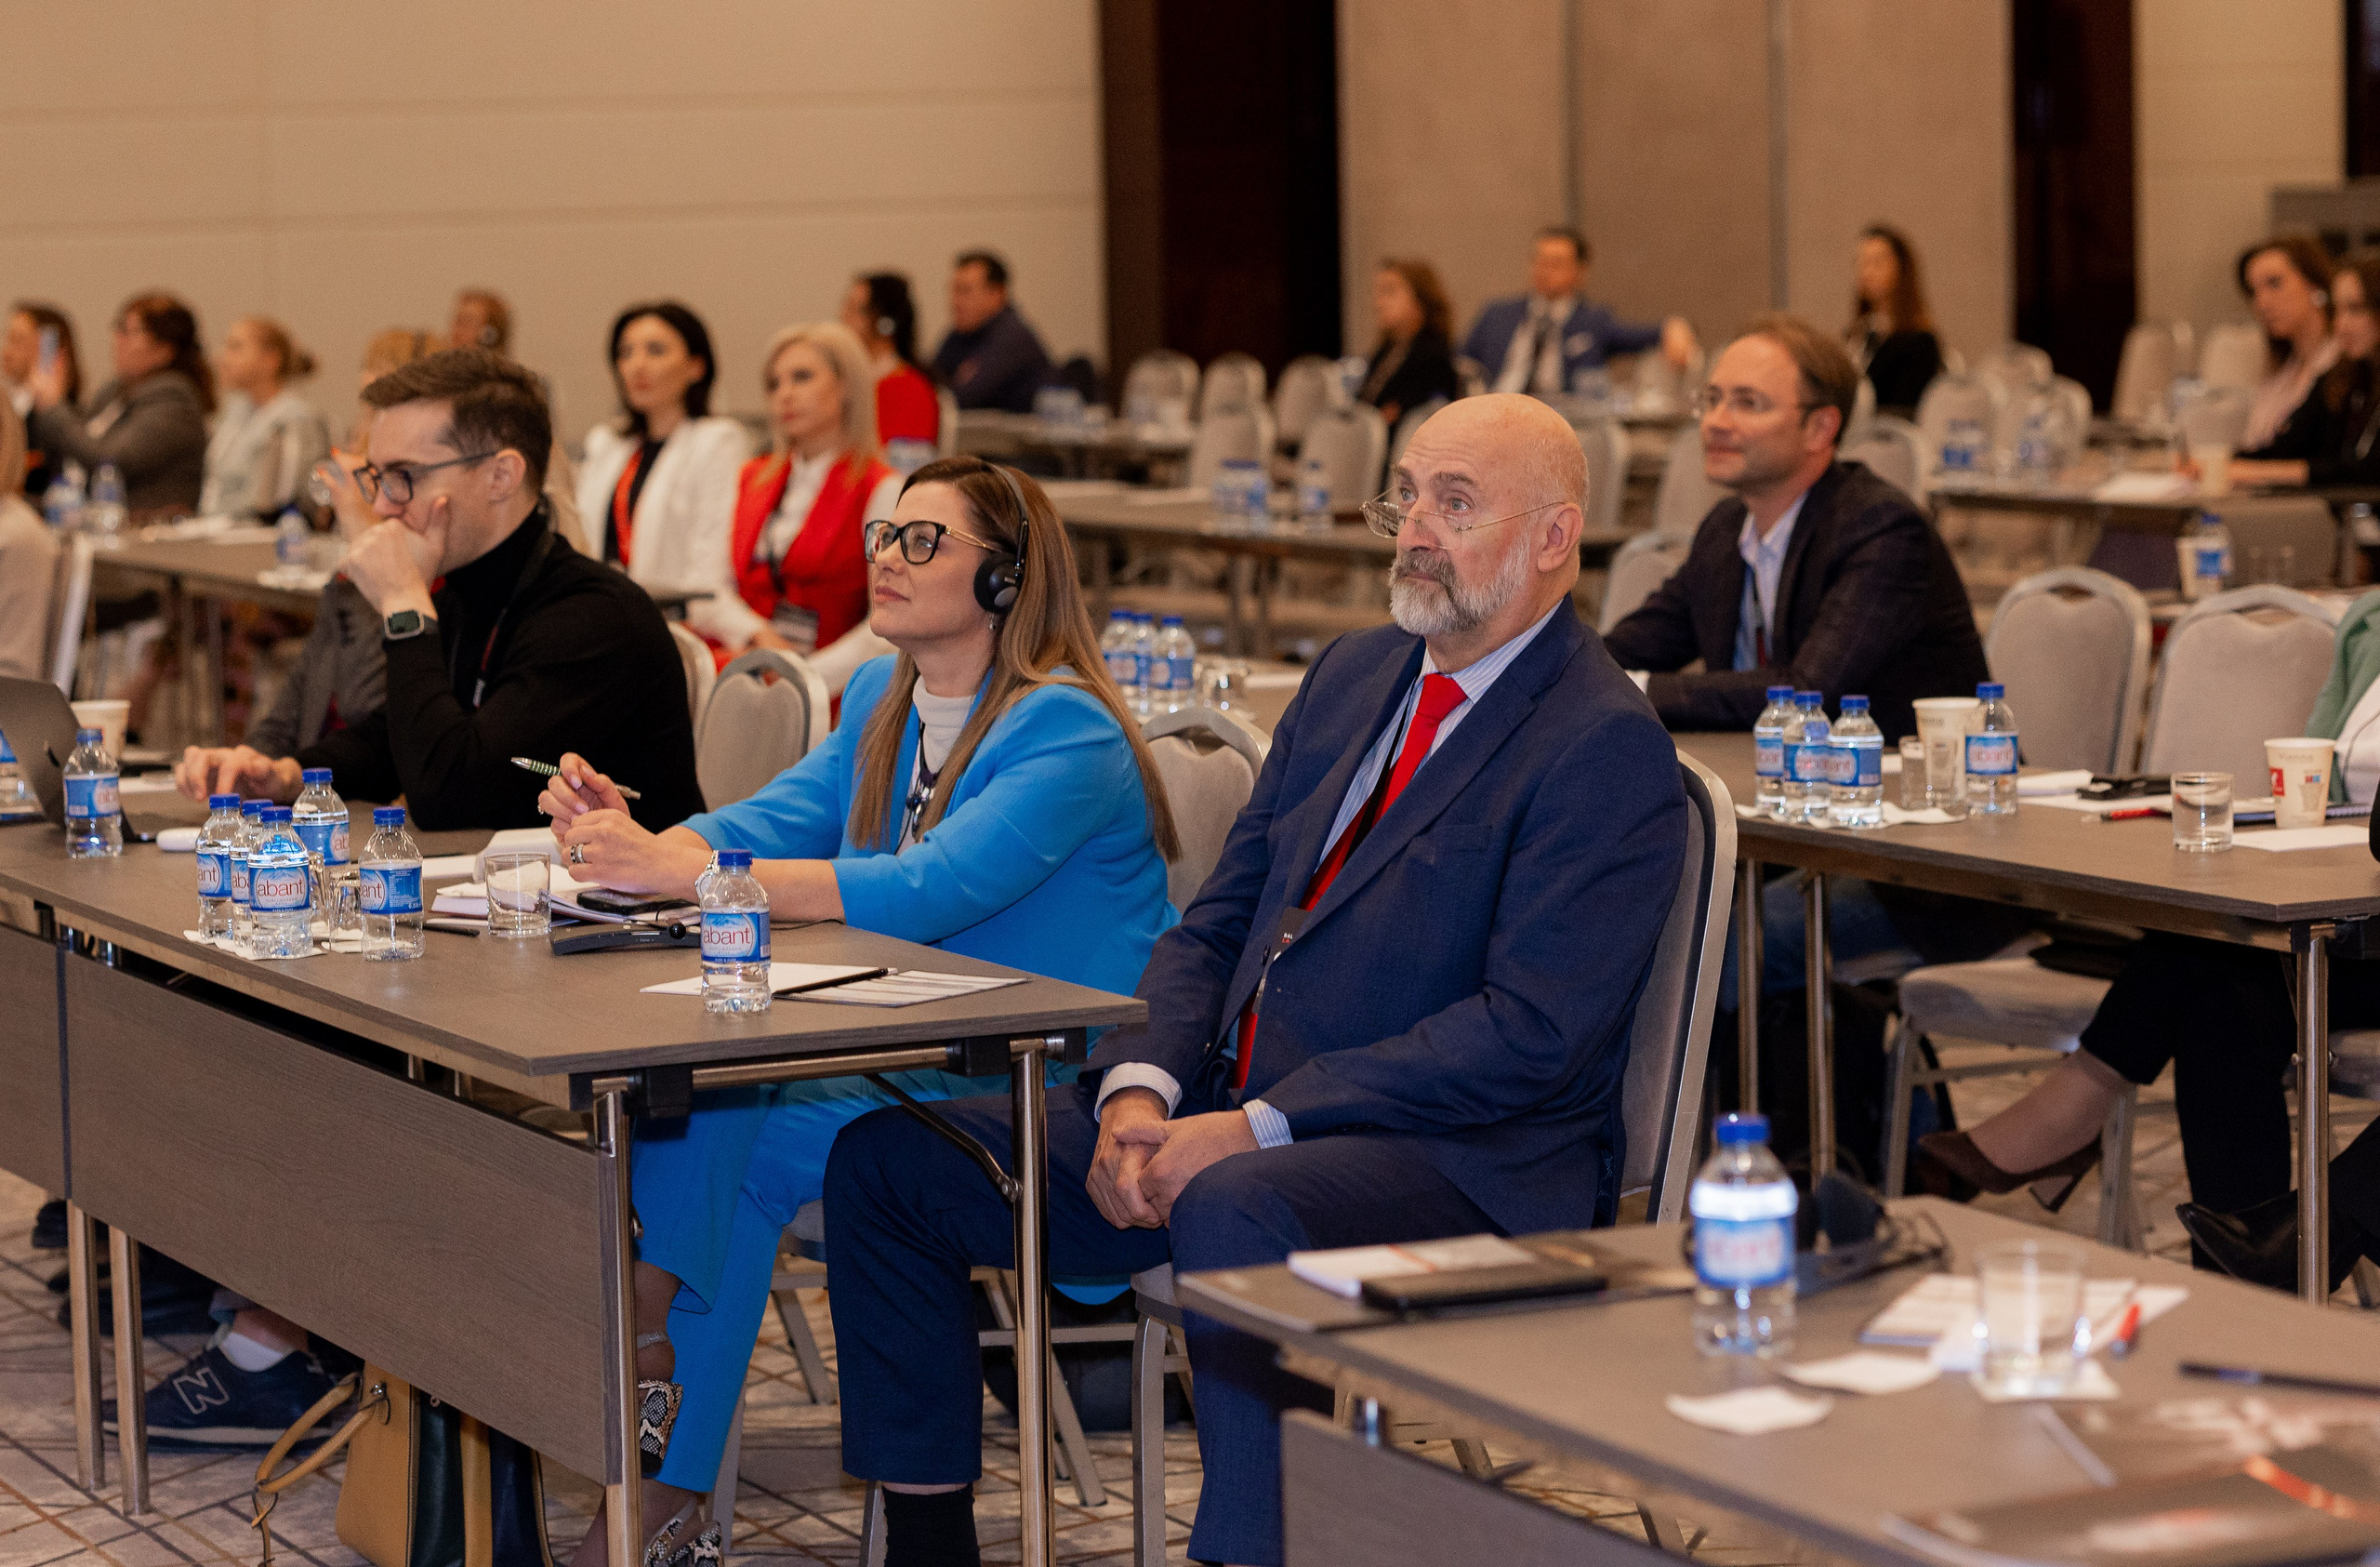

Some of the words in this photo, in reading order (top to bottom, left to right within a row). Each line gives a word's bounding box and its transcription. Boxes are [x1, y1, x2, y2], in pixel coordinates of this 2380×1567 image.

[232, 871, 249, 889] ab
[258, 879, 304, 897] abant
[360, 883, 382, 899] ant
[703, 926, 751, 945] abant
[173, 1367, 230, 1414] N
